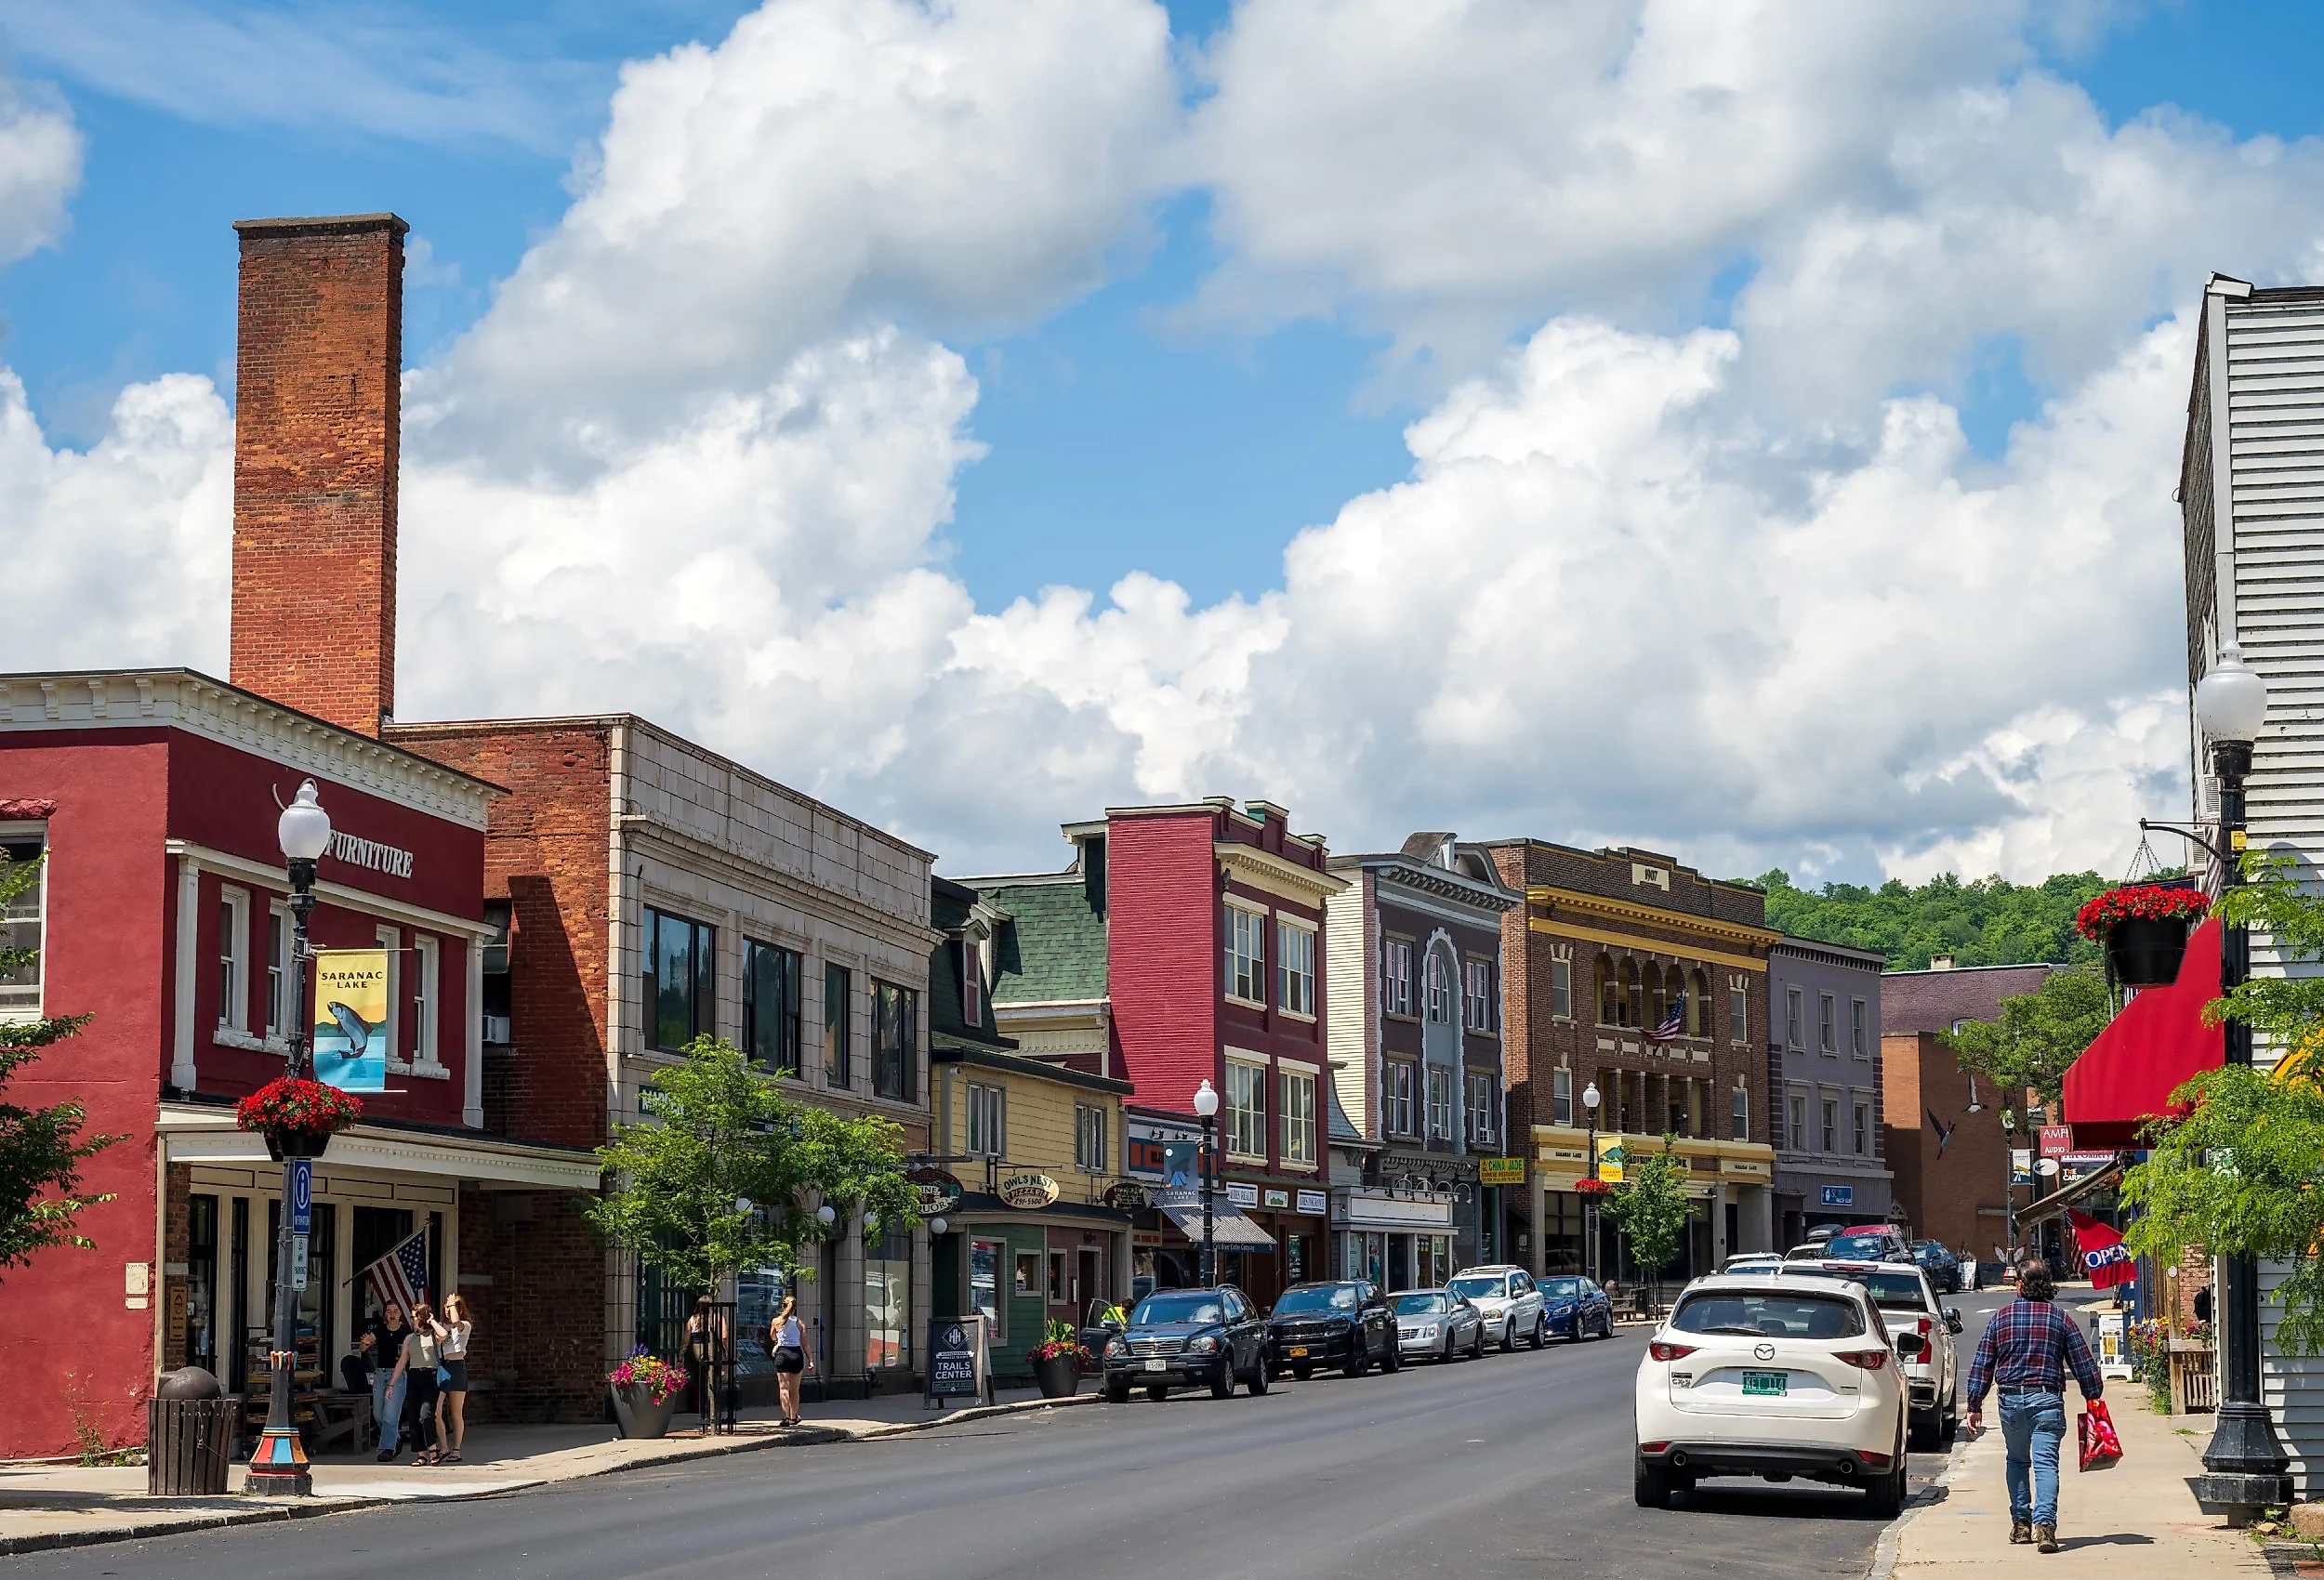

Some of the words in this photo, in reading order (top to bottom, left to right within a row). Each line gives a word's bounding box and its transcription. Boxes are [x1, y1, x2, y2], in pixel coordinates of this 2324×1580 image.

[324, 828, 414, 878] FURNITURE
[1644, 868, 1658, 882] 1907
[321, 971, 383, 981] SARANAC
[337, 981, 368, 989] LAKE
[1488, 1160, 1505, 1171] CHINA
[1508, 1160, 1523, 1170] JADE
[2063, 1167, 2078, 1176] THE
[1029, 1174, 1054, 1189] NEST
[919, 1185, 939, 1195] INE
[1010, 1189, 1049, 1200] PIZZERIA
[918, 1201, 946, 1214] QUOR
[2085, 1244, 2132, 1267] OPEN
[937, 1361, 971, 1371] TRAILS
[935, 1369, 972, 1380] CENTER
[1746, 1377, 1763, 1390] KET
[1767, 1377, 1784, 1391] 114
